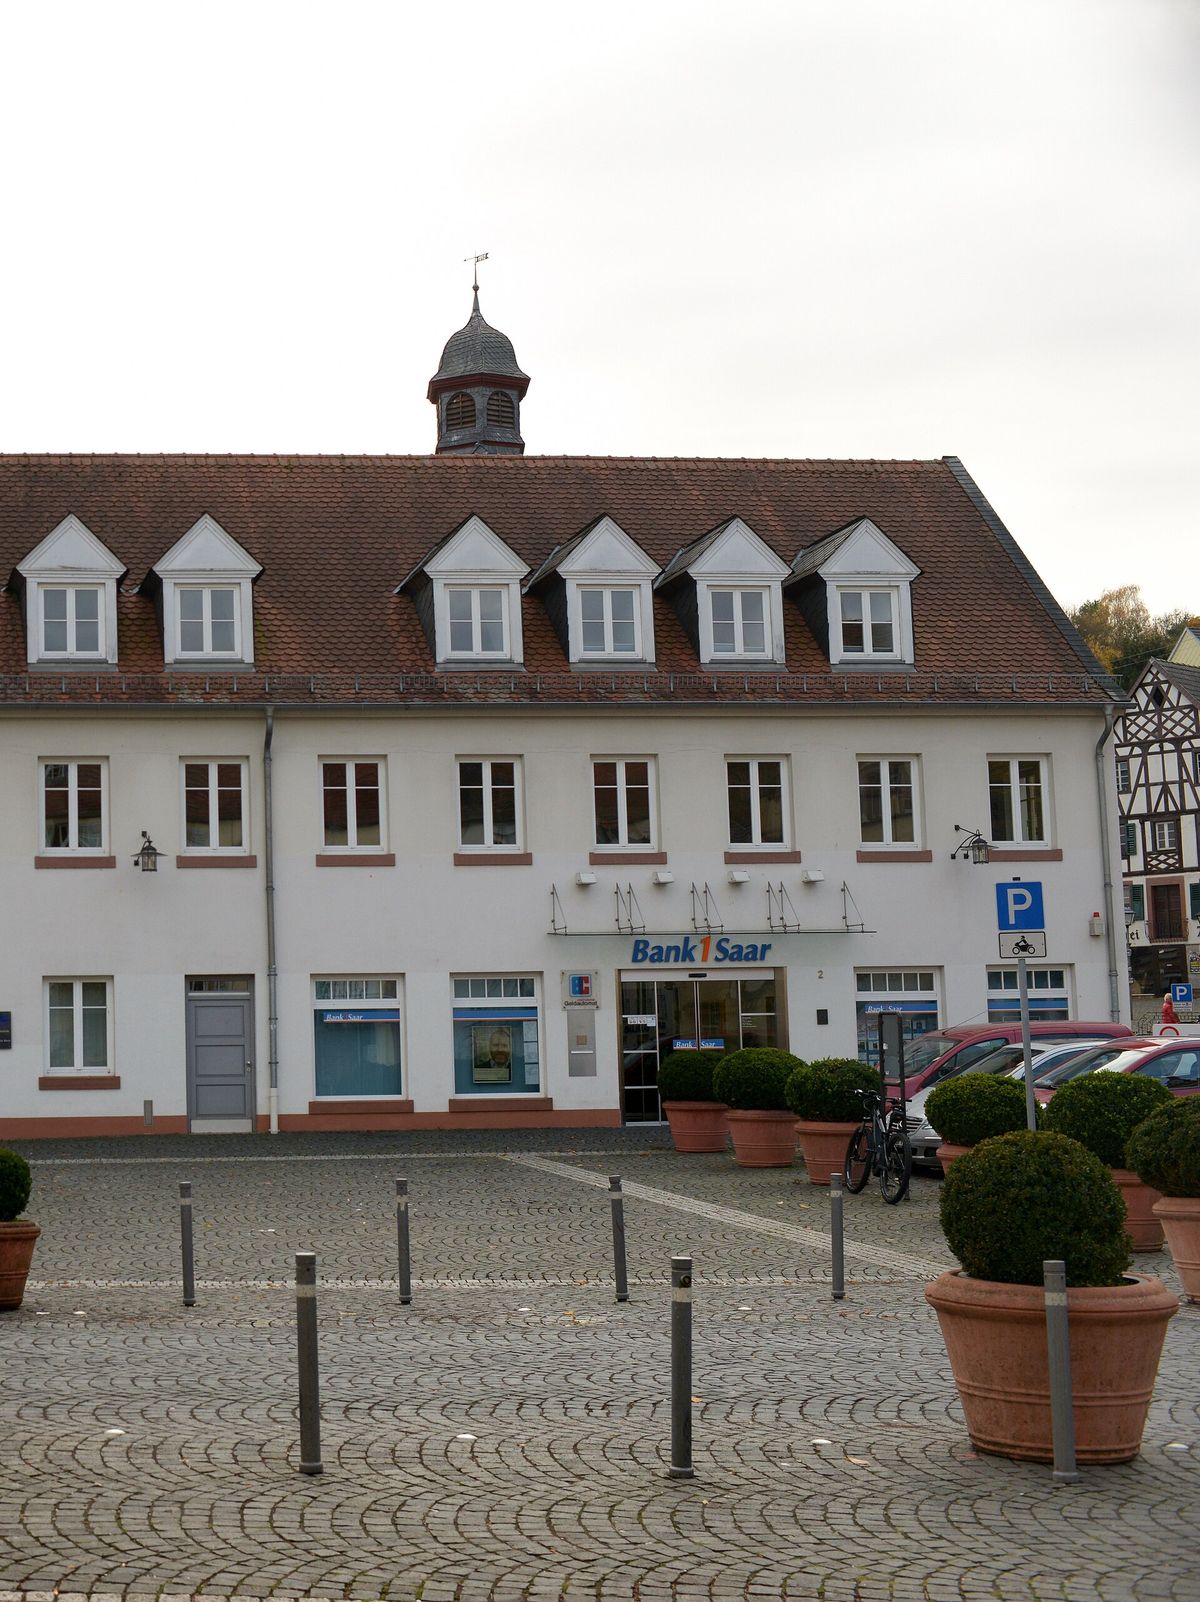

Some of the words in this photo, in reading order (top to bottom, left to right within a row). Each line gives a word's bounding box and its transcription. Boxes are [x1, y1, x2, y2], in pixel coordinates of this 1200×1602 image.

[1007, 888, 1032, 924] P
[631, 936, 697, 963] Bank
[714, 938, 772, 962] Saar
[817, 970, 824, 979] 2
[1176, 986, 1188, 1000] P
